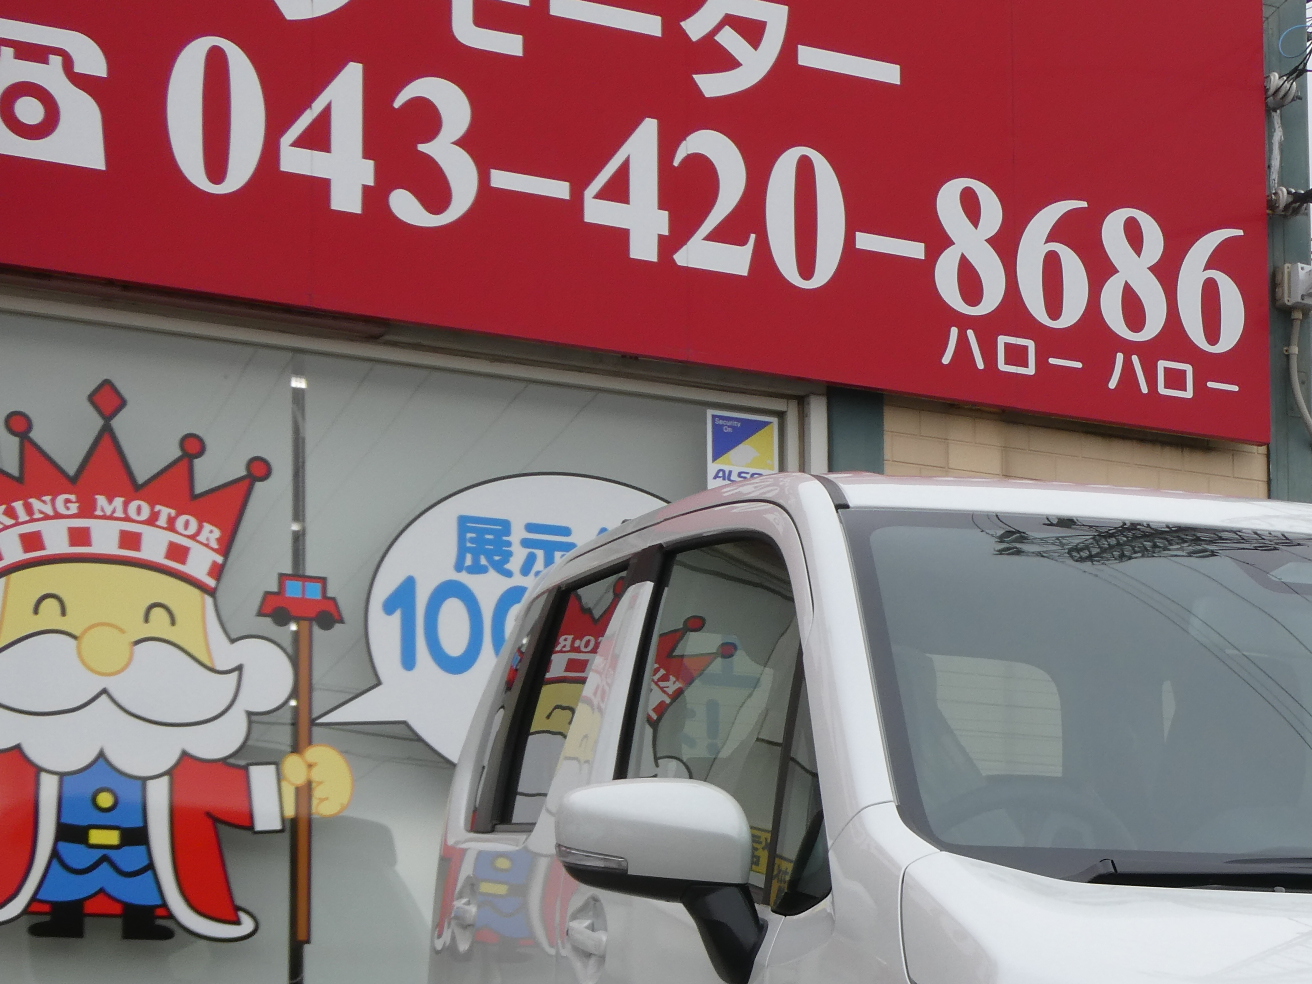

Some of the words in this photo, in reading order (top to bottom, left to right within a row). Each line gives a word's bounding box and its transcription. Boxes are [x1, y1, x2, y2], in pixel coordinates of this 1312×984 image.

[166, 36, 1245, 353] 043-420-8686
[941, 326, 1083, 376] ハロー
[1108, 352, 1240, 399] ハロー
[714, 417, 742, 428] Security
[94, 495, 222, 549] MOTOR
[454, 514, 608, 578] 展示
